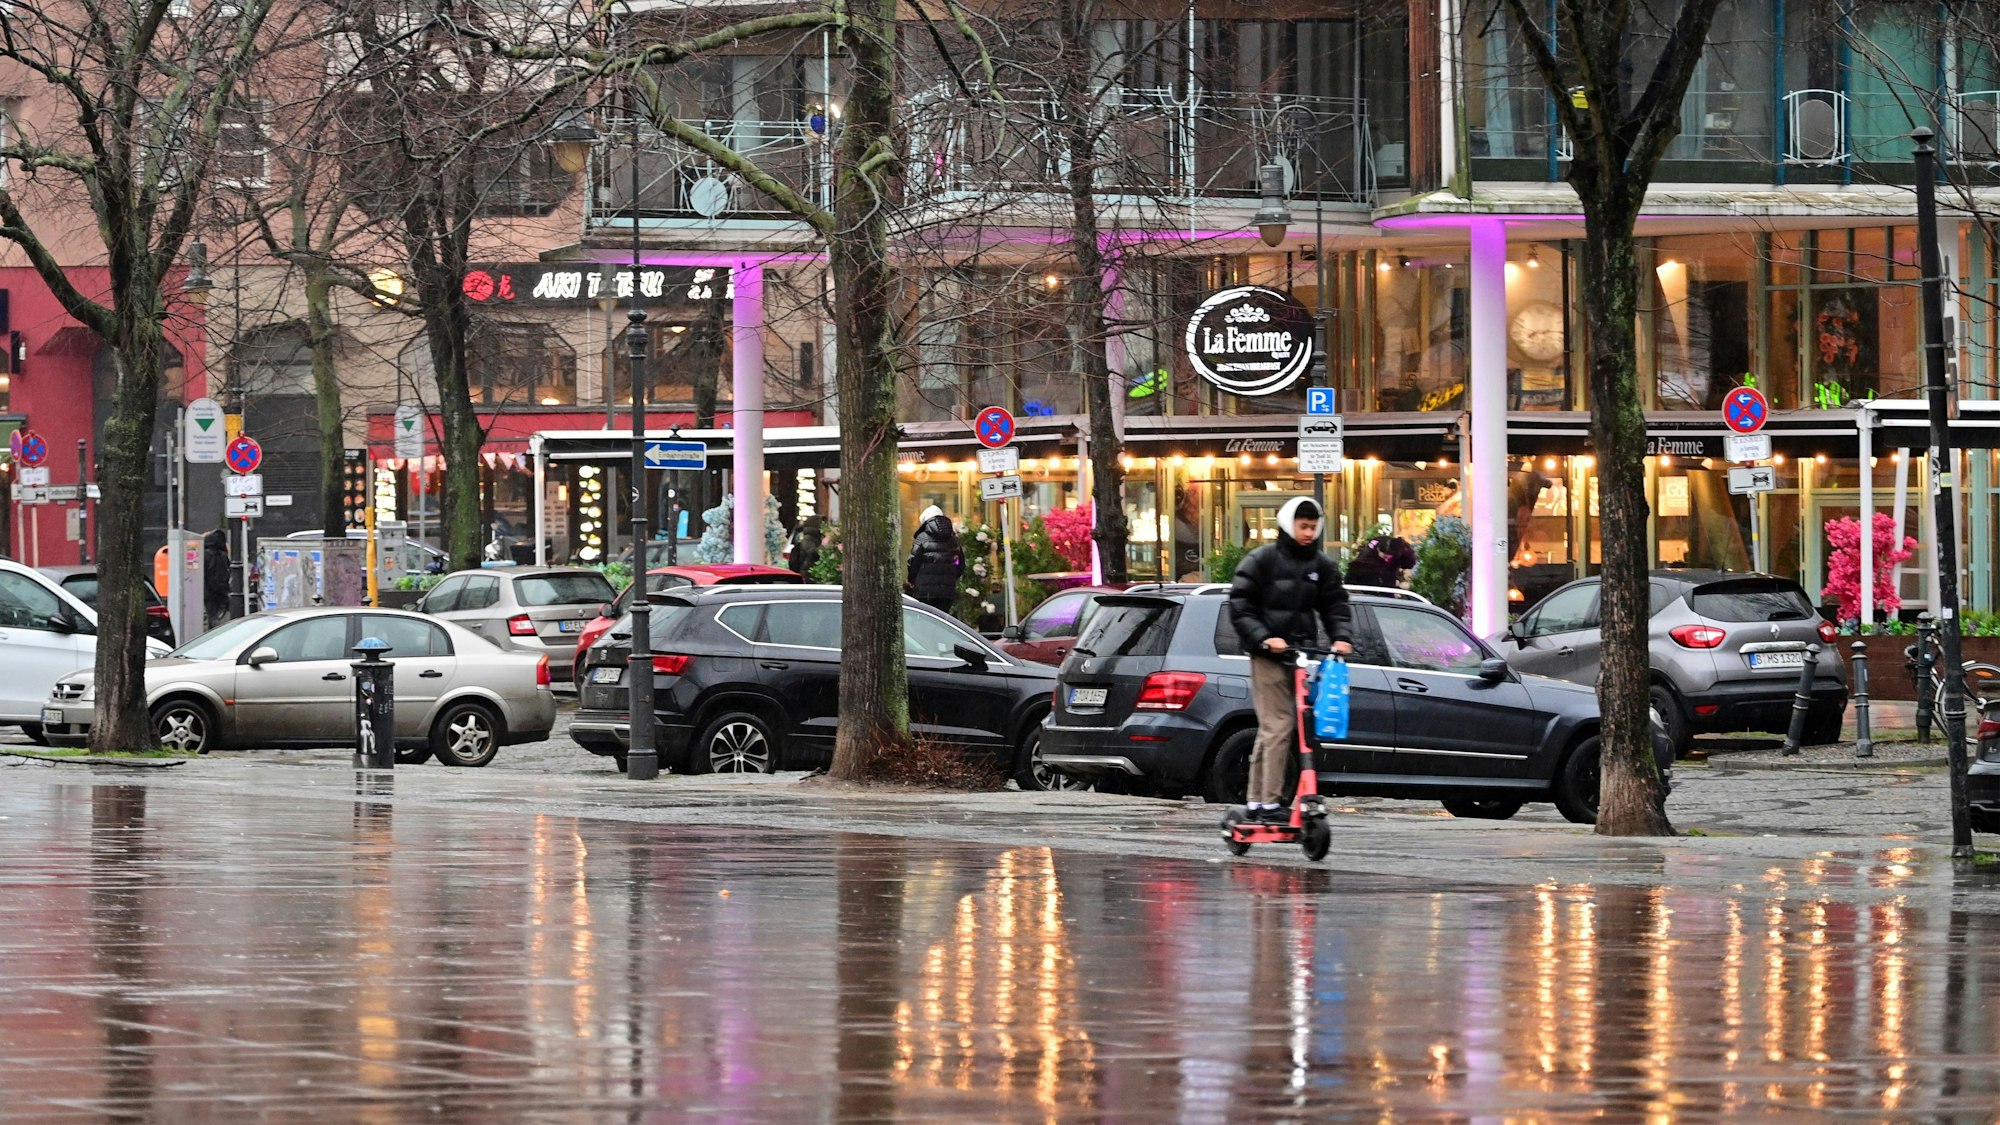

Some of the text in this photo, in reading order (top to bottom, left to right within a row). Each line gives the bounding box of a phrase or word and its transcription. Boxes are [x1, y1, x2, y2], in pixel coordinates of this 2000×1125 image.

[1203, 326, 1292, 354] La Femme
[1311, 391, 1327, 412] P
[1225, 438, 1285, 453] La Femme
[1657, 437, 1704, 454] Femme
[1418, 486, 1446, 501] Pasta
[1756, 653, 1801, 664] B MS 1320
